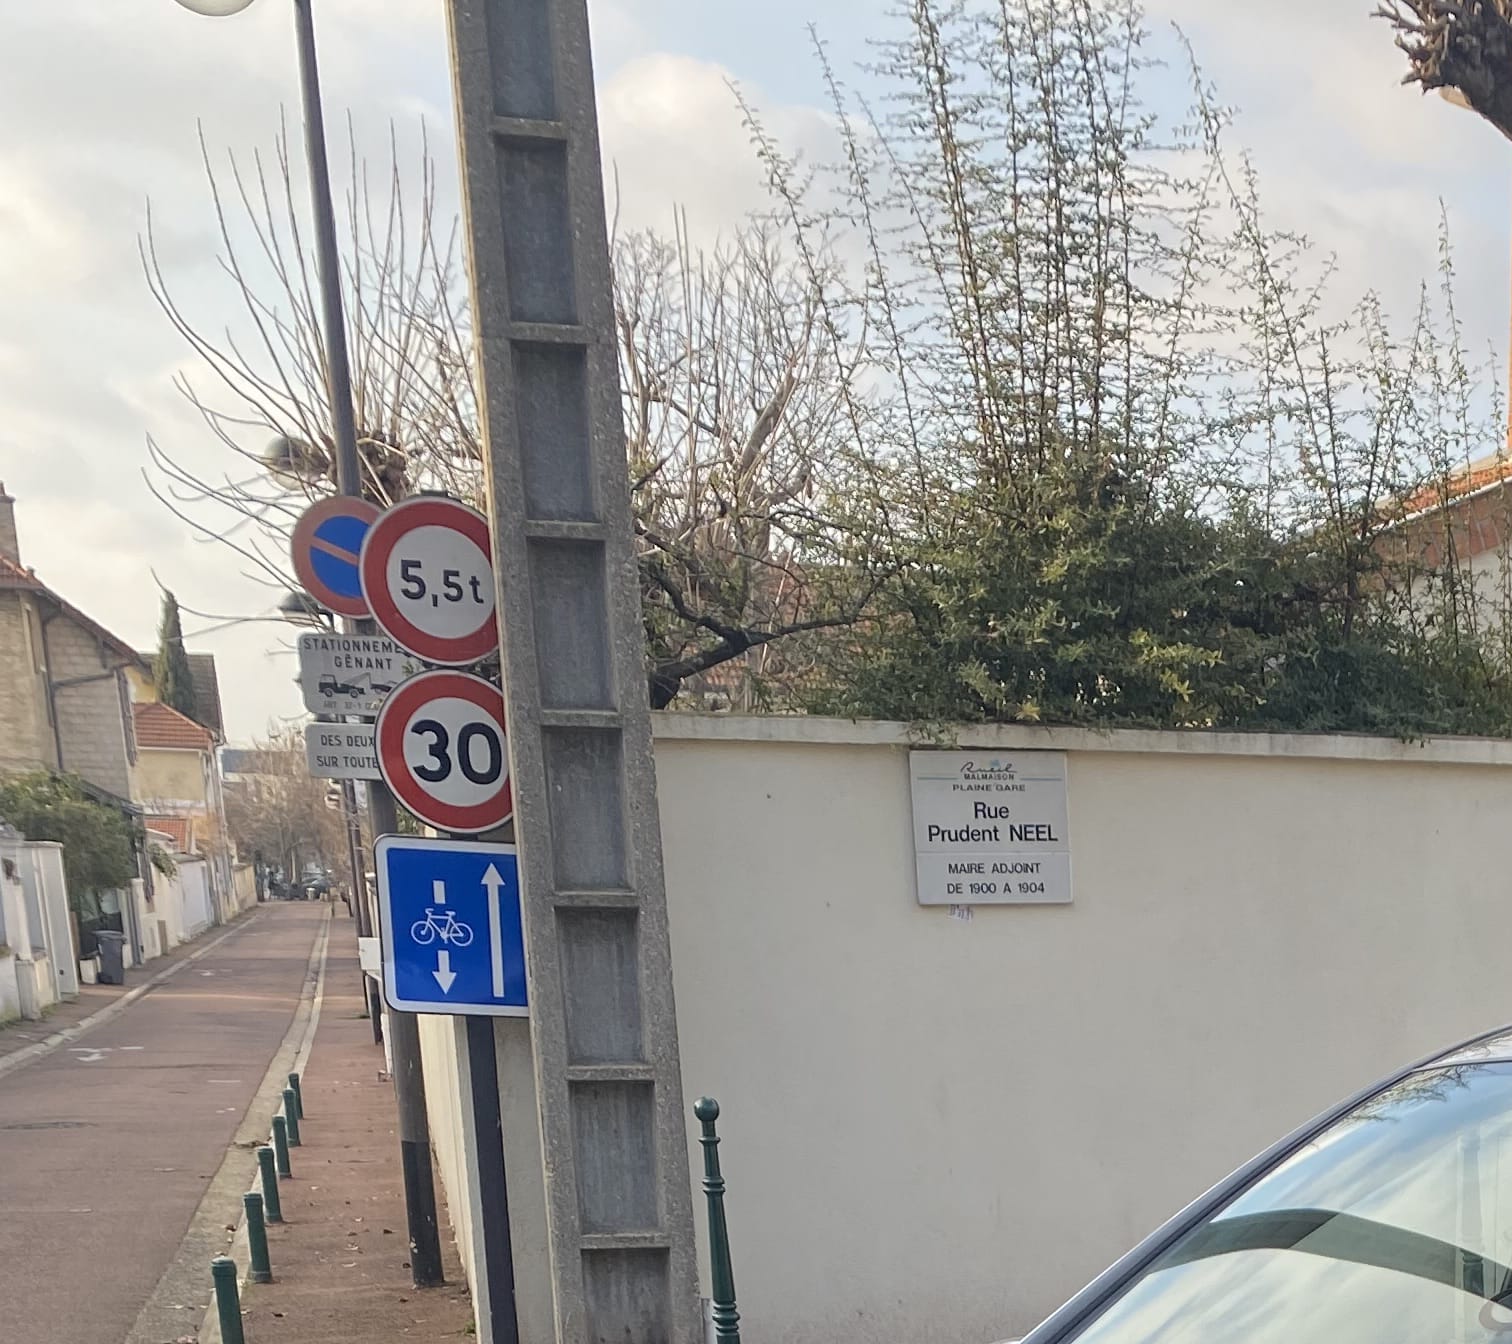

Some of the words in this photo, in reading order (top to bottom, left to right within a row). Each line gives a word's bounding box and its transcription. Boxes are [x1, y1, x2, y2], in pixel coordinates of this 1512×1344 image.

[304, 638, 411, 657] STATIONNEME
[334, 654, 392, 669] GÊNANT
[321, 735, 341, 746] DES
[347, 735, 375, 747] DEUX
[411, 720, 502, 785] 30
[317, 756, 338, 768] SUR
[960, 761, 1017, 773] Rueil
[974, 801, 1010, 819] Rue
[928, 825, 999, 842] Prudent
[1009, 824, 1058, 841] NEEL
[948, 863, 985, 874] MAIRE
[991, 863, 1041, 873] ADJOINT
[947, 883, 963, 894] DE
[969, 883, 997, 894] 1900
[1003, 883, 1012, 893] A
[1018, 882, 1045, 893] 1904
